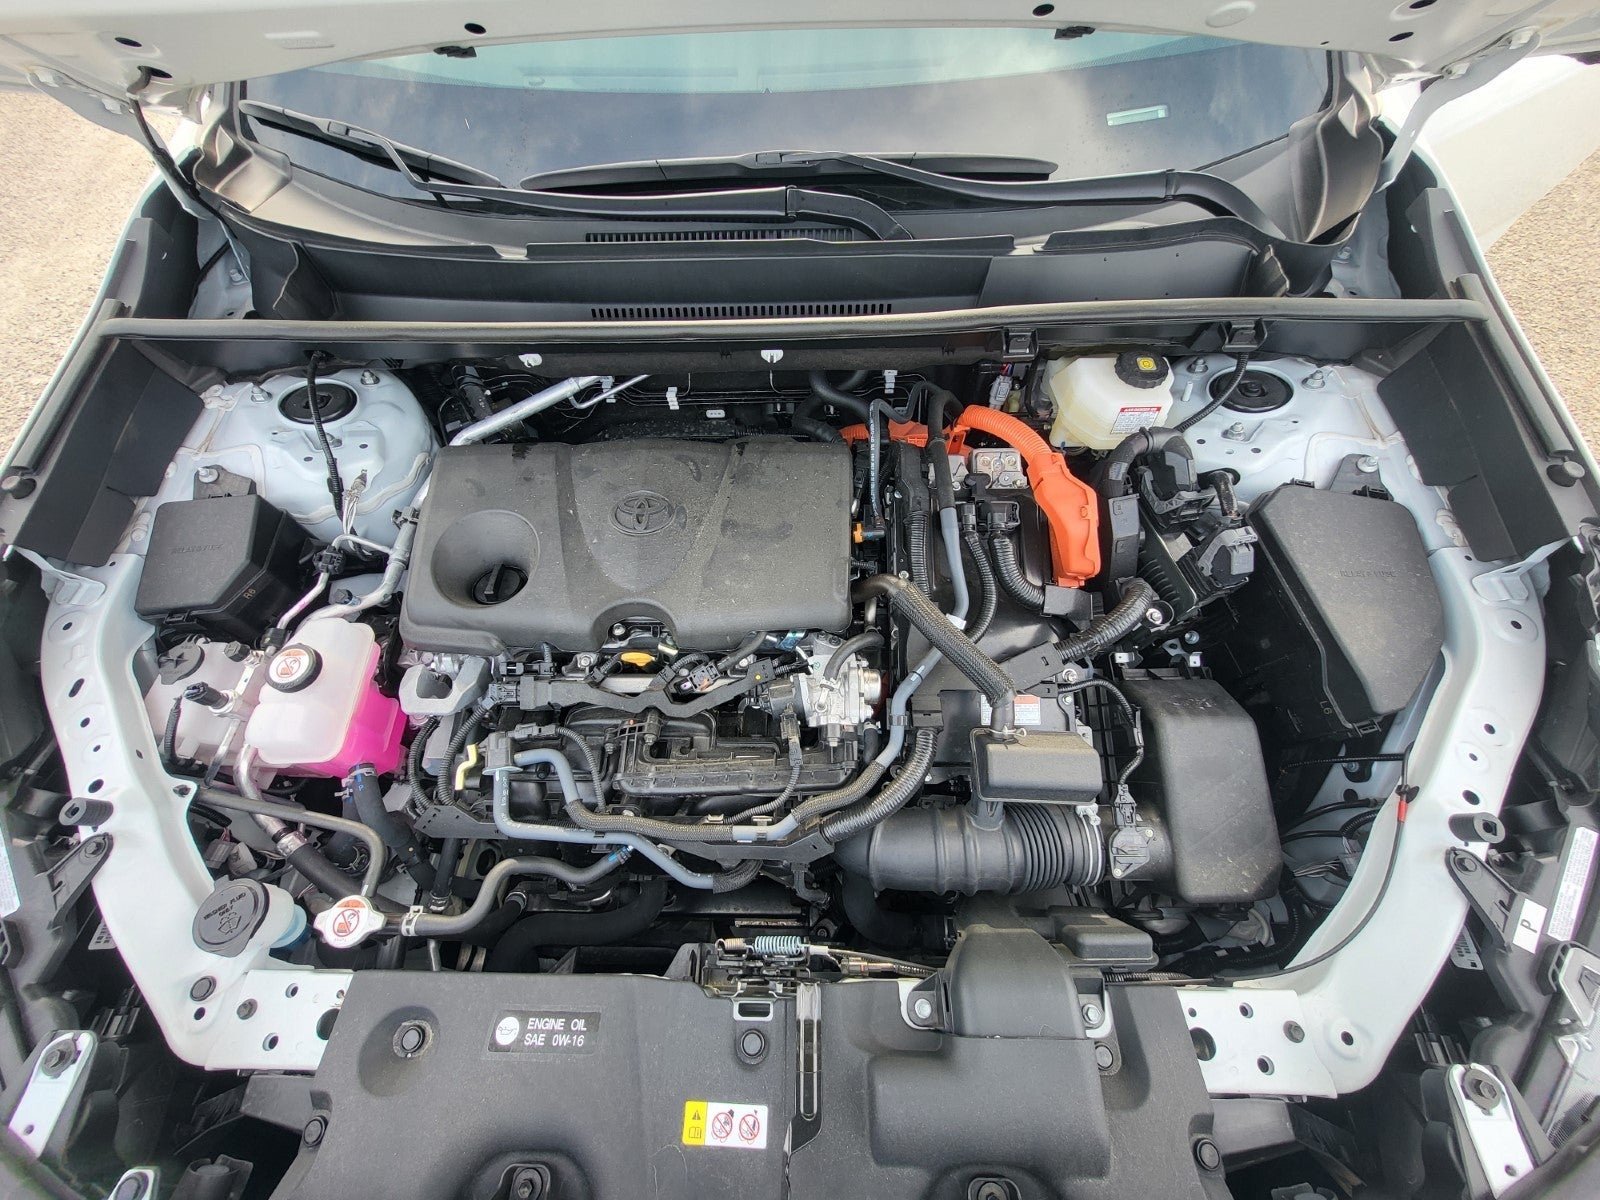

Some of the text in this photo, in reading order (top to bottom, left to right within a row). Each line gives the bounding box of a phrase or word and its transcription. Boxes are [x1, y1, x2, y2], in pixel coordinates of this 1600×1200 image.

[527, 1017, 588, 1032] ENGINE OIL
[523, 1033, 586, 1047] SAE 0W-16
